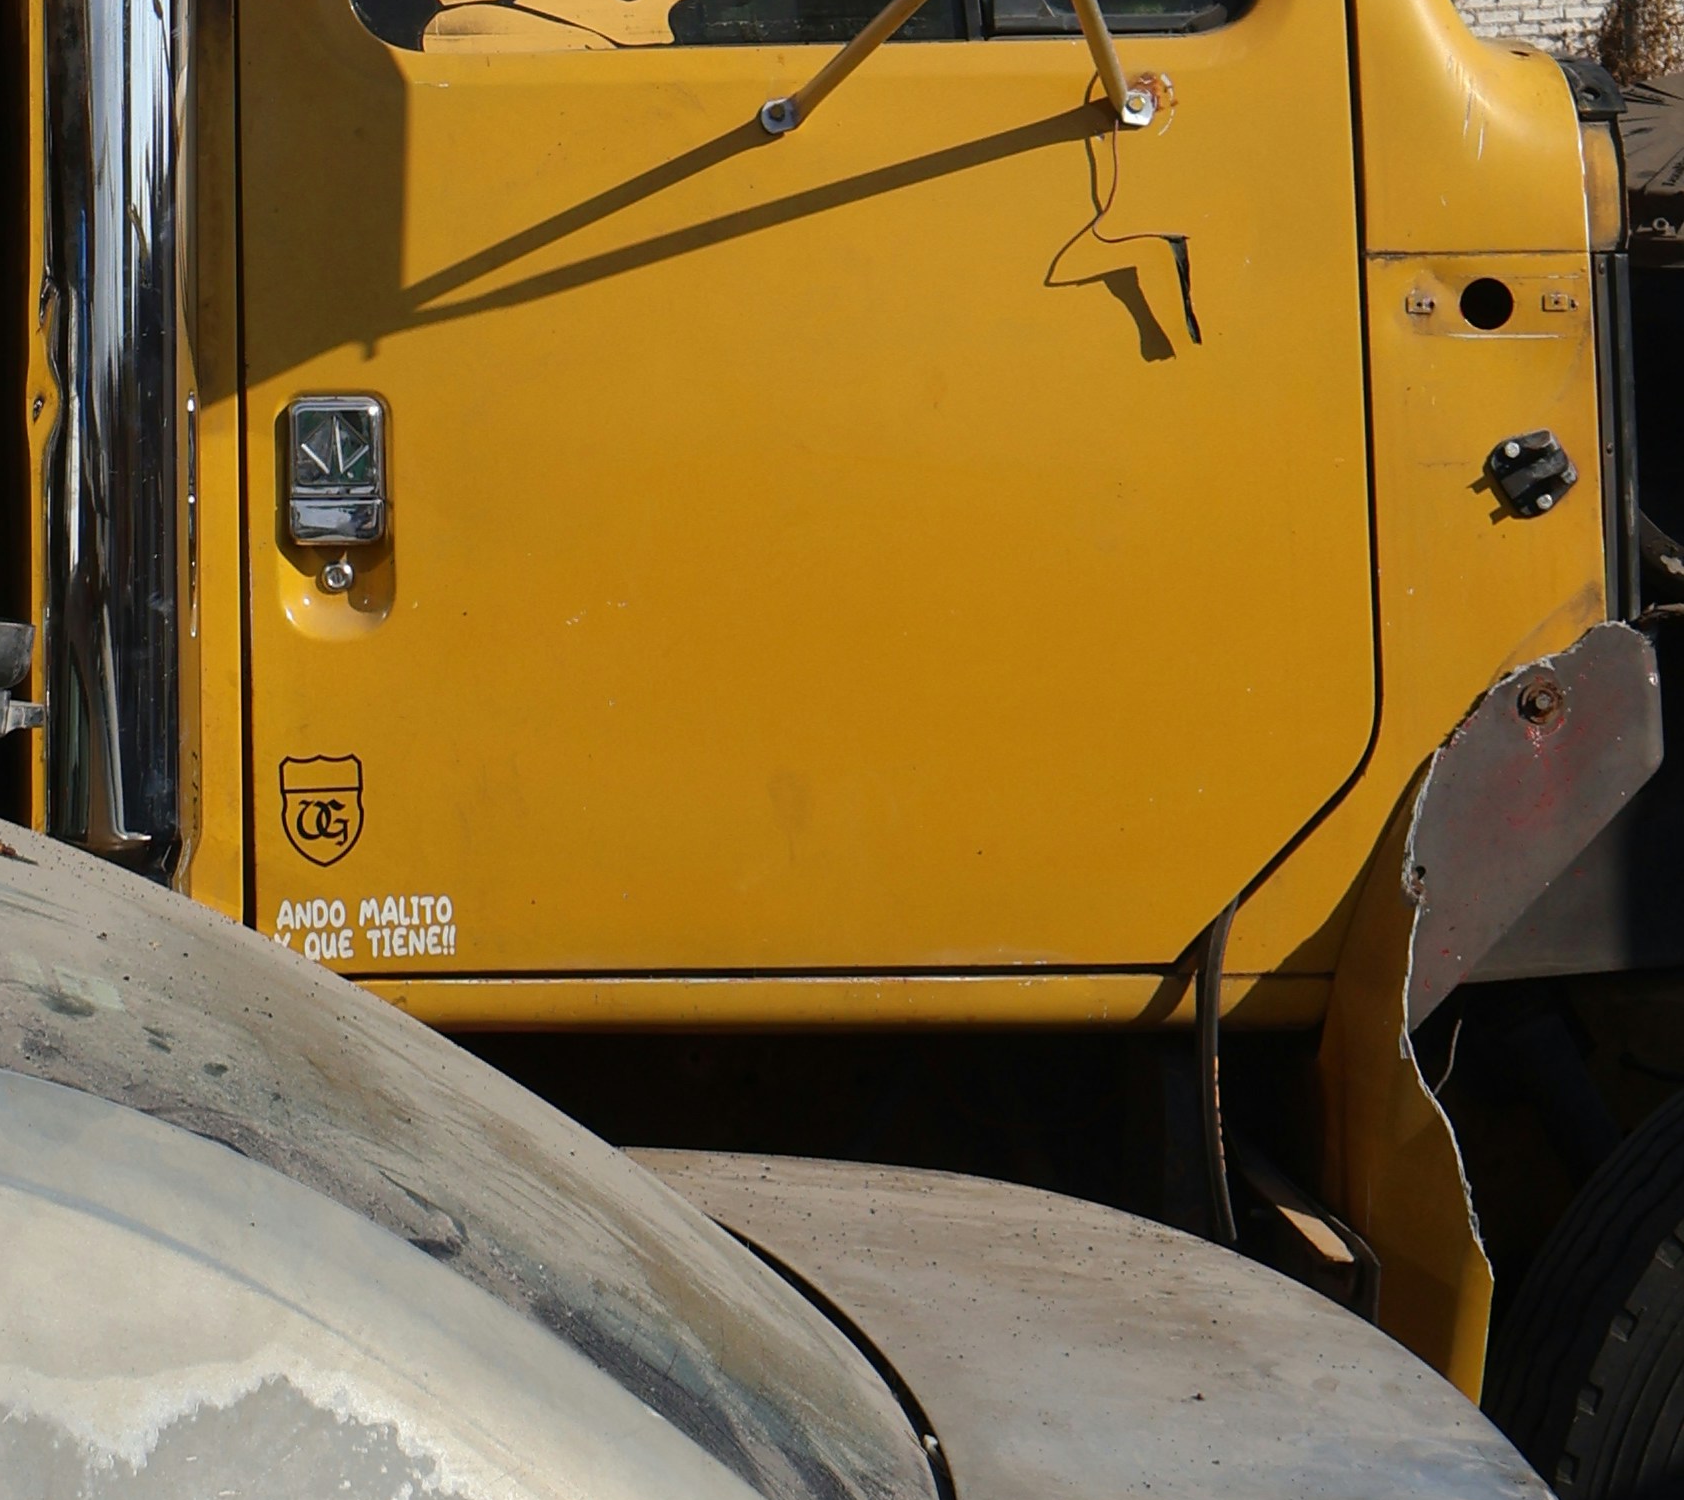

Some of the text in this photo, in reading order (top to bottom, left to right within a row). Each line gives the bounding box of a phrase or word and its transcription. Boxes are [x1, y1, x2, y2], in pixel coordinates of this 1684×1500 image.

[276, 895, 453, 930] ANDO MALITO
[304, 929, 354, 960] QUE
[366, 925, 457, 958] TIENE!!
